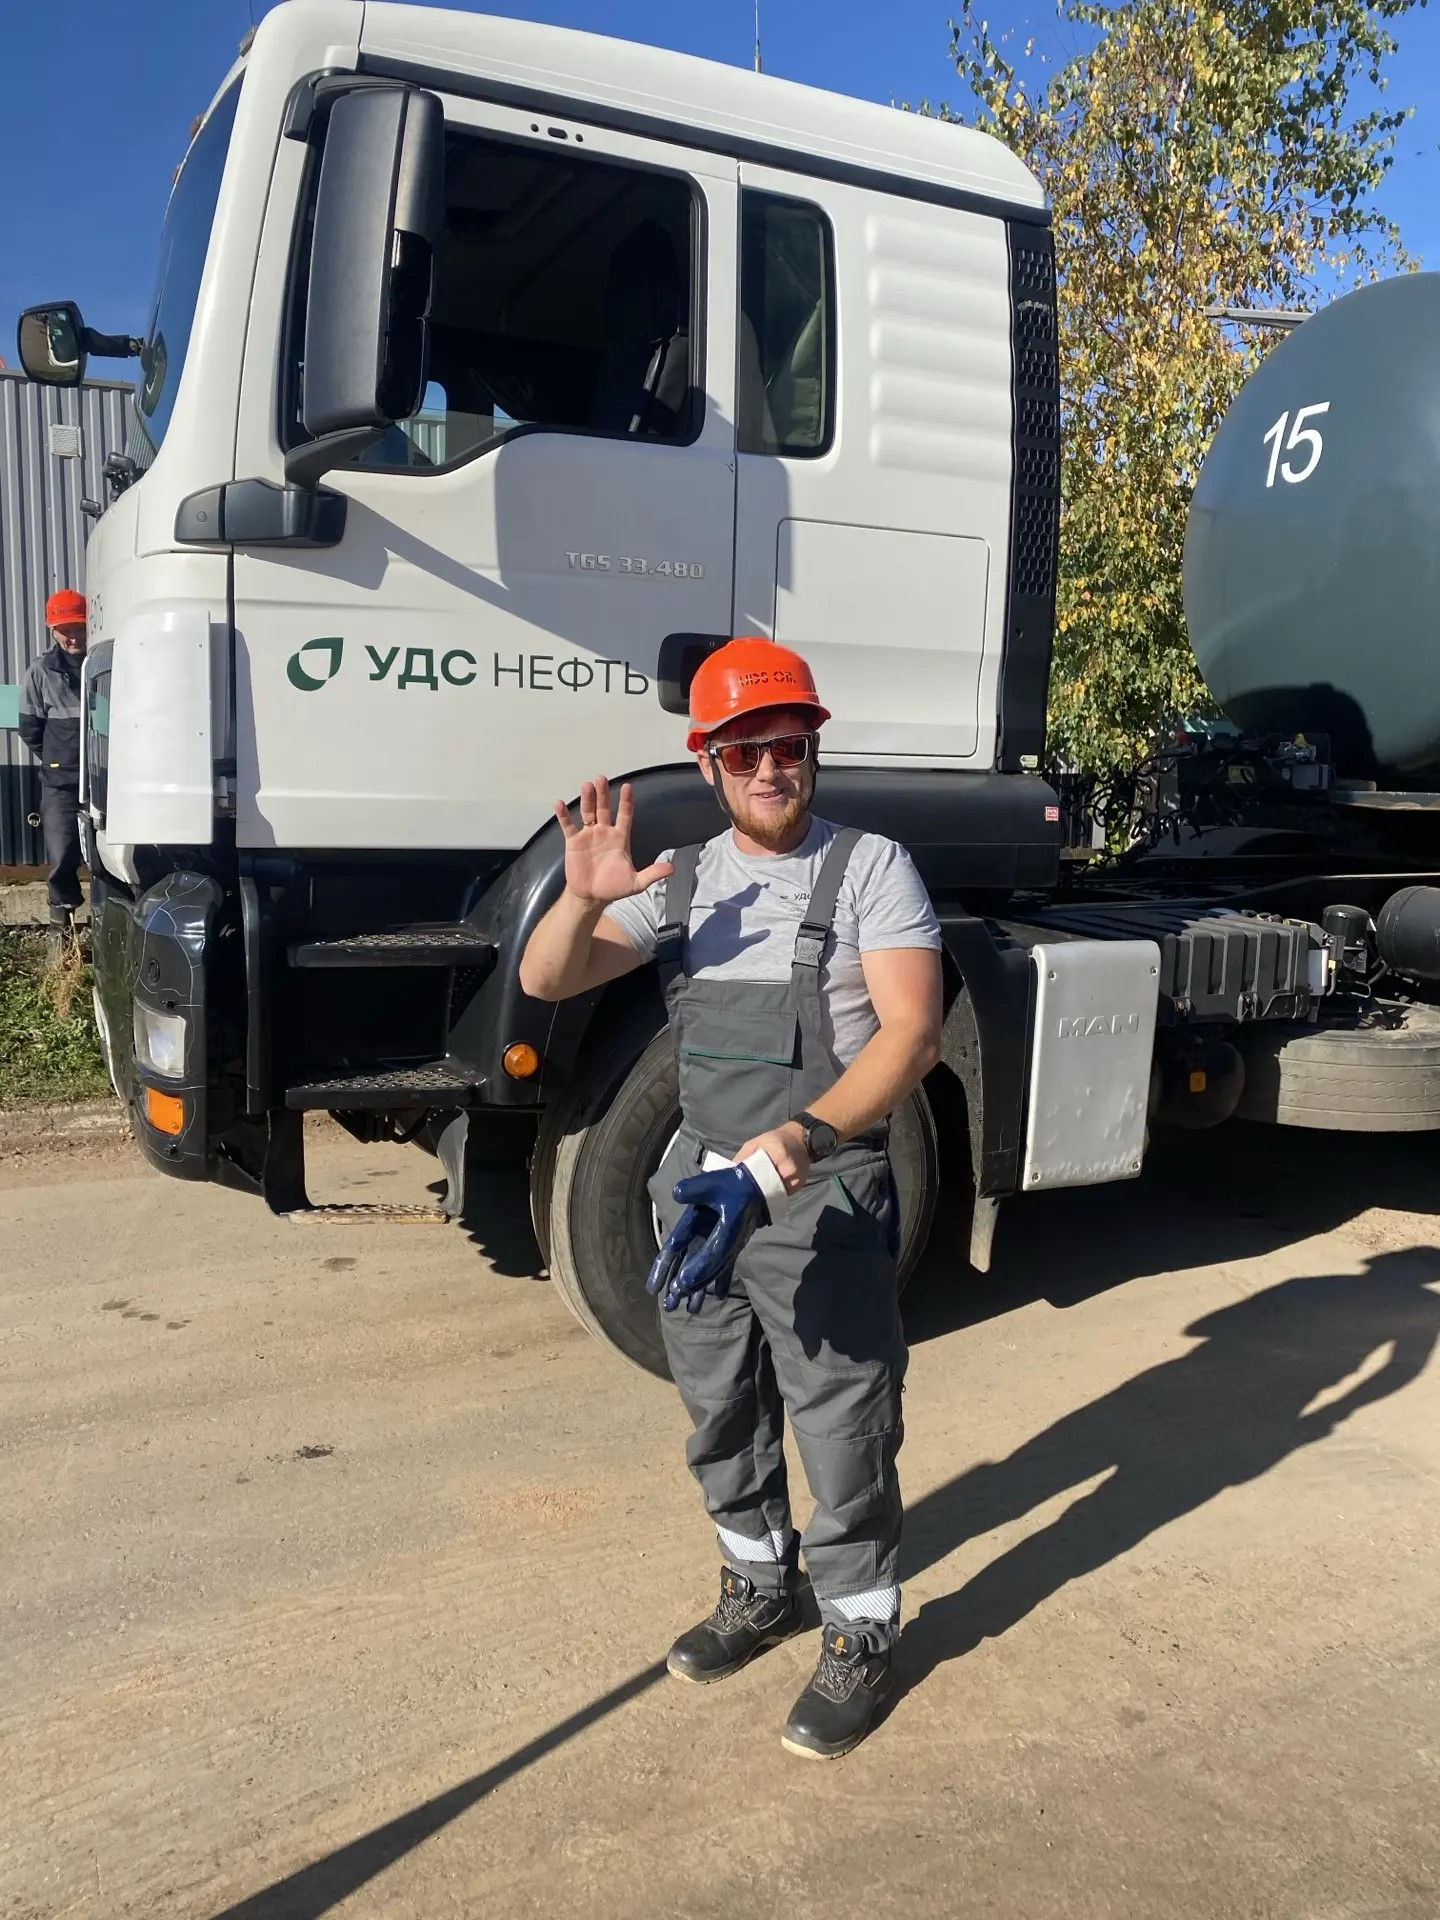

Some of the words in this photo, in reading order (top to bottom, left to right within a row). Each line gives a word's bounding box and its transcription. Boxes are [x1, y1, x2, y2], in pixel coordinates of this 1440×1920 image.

[1263, 401, 1330, 488] 15
[565, 551, 611, 571] TGS
[618, 556, 704, 579] 33.480
[364, 645, 477, 691] УДС
[494, 652, 649, 695] НЕФТЬ
[1058, 1013, 1140, 1038] MAN
